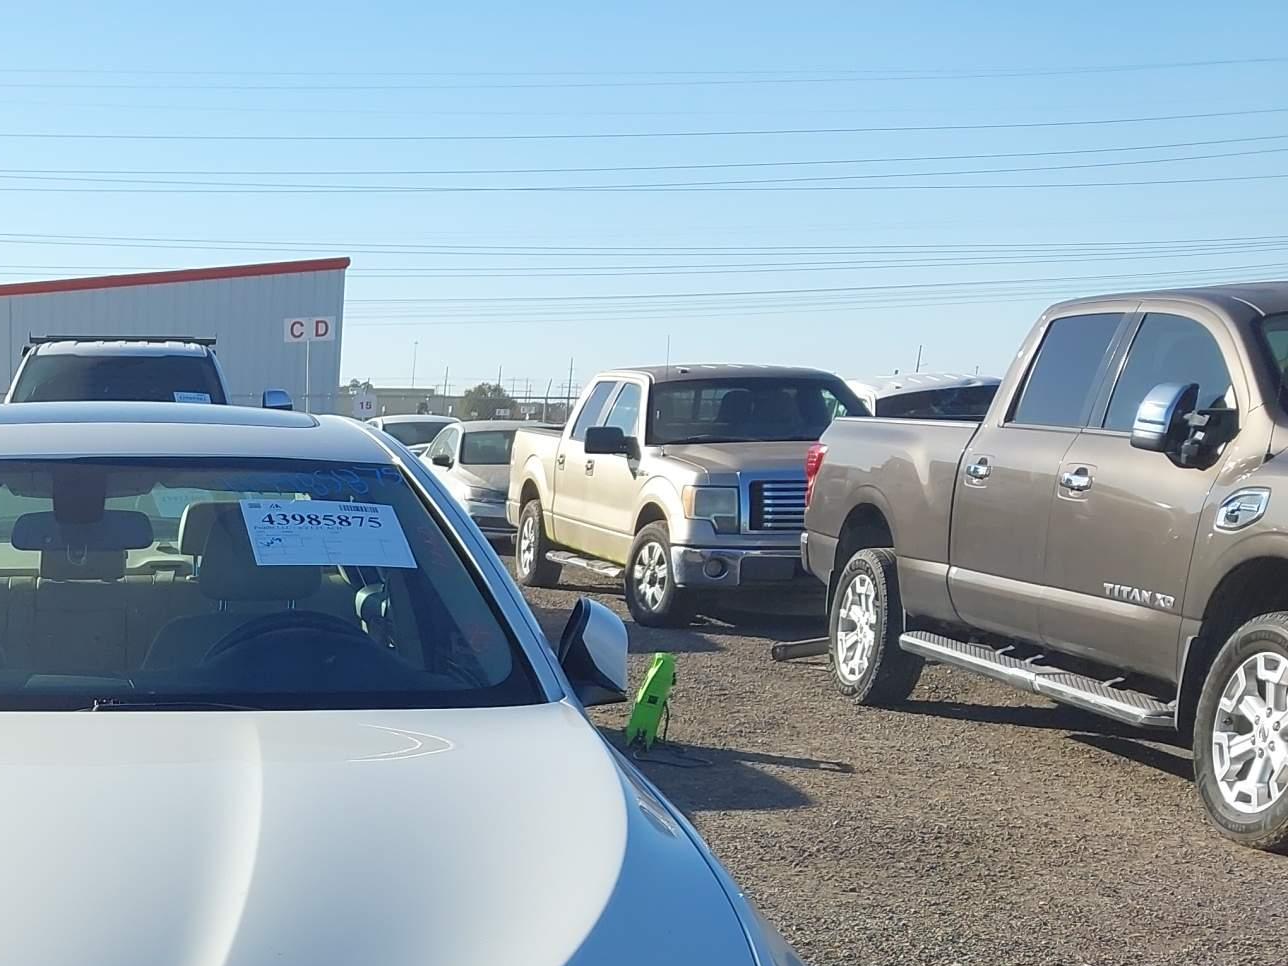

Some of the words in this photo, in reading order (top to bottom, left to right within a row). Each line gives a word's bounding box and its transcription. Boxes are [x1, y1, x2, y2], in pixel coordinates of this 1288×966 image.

[290, 320, 305, 338] C
[315, 319, 329, 337] D
[359, 401, 373, 410] 15
[262, 512, 383, 529] 43985875
[1103, 582, 1152, 605] TITAN
